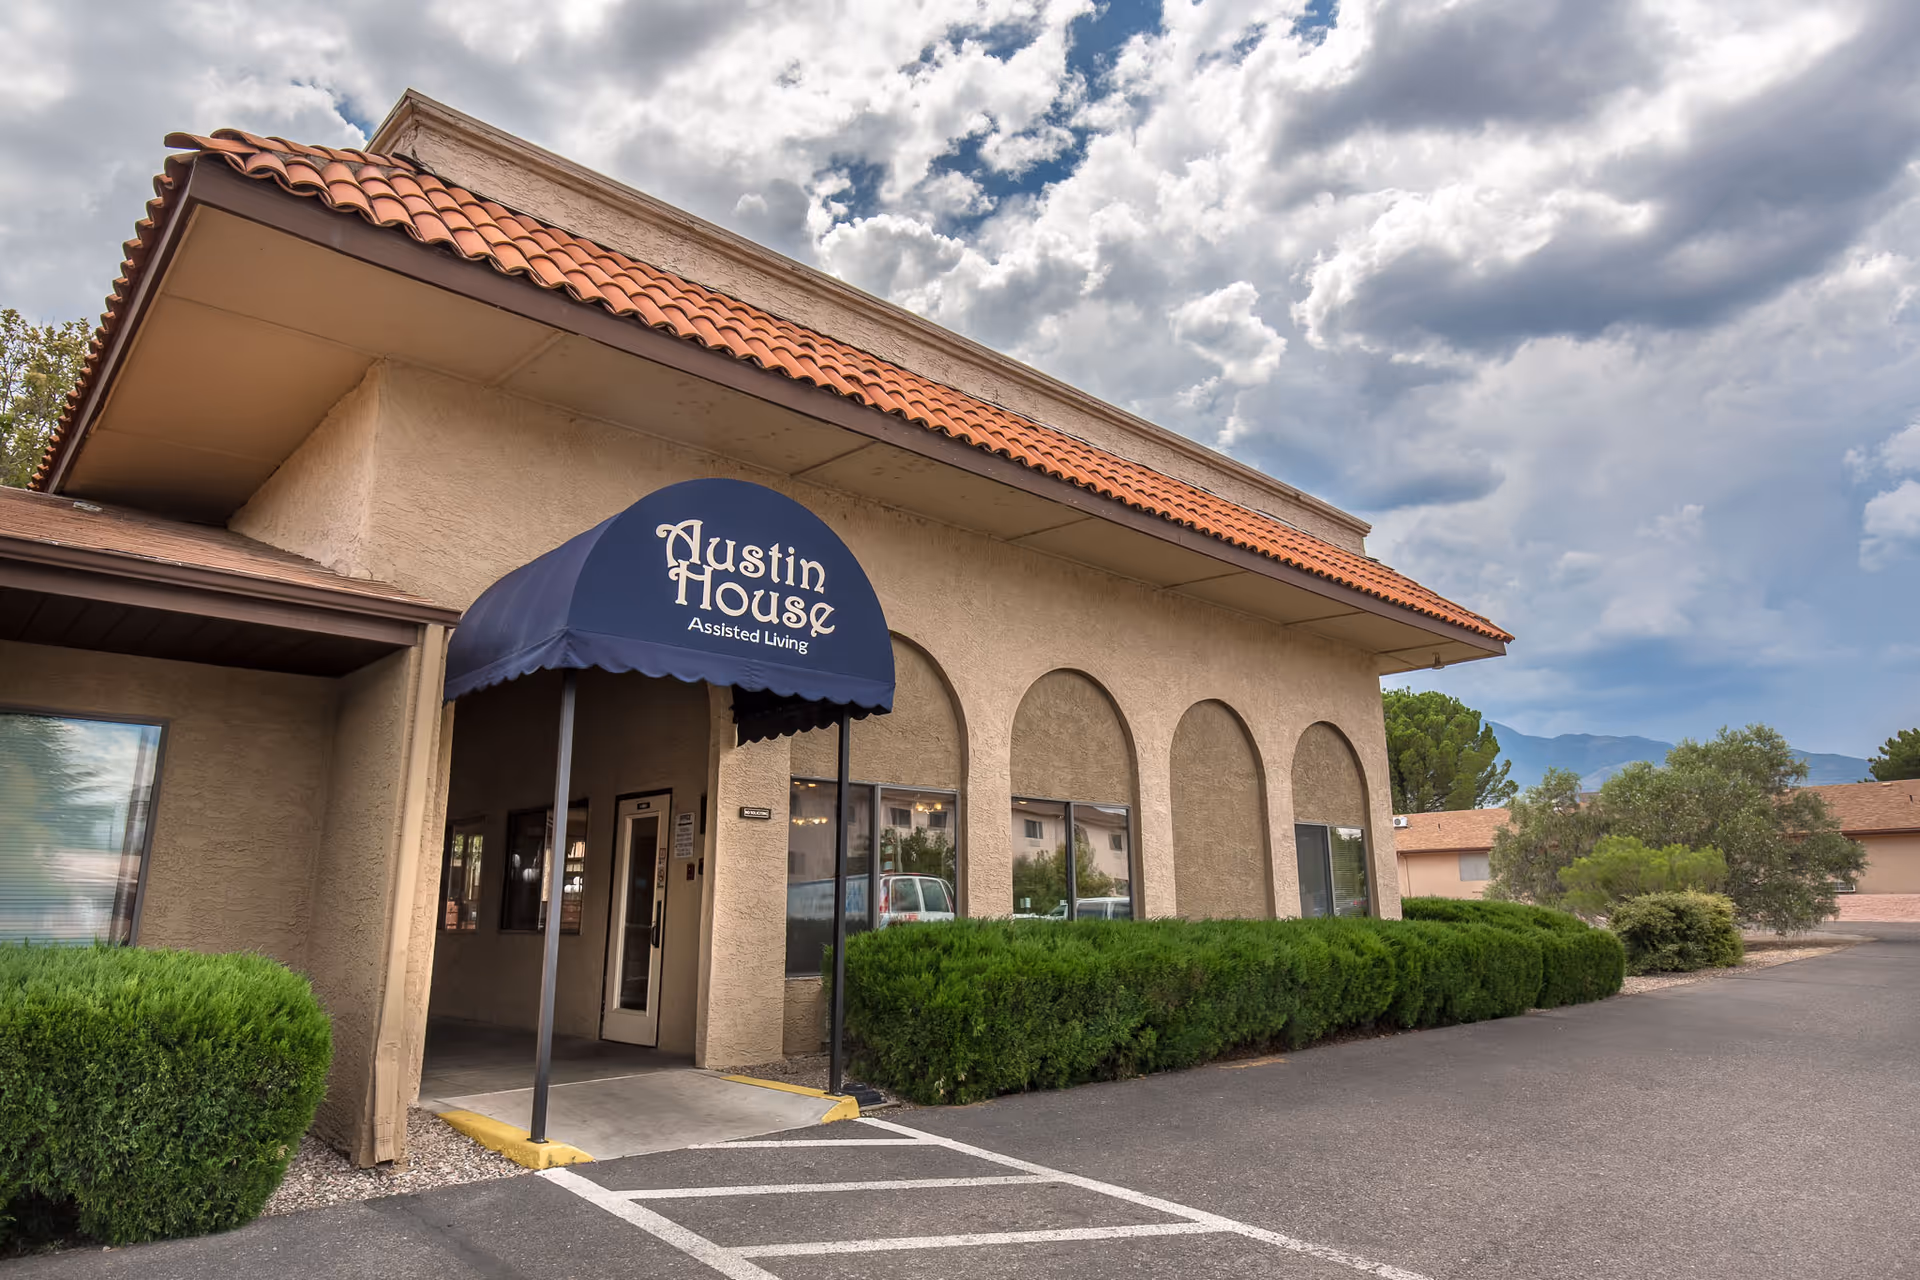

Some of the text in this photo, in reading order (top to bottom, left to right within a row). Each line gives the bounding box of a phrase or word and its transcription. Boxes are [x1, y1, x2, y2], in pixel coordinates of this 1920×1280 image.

[655, 519, 826, 594] Austin
[668, 559, 836, 637] House
[687, 617, 809, 655] Assisted Living
